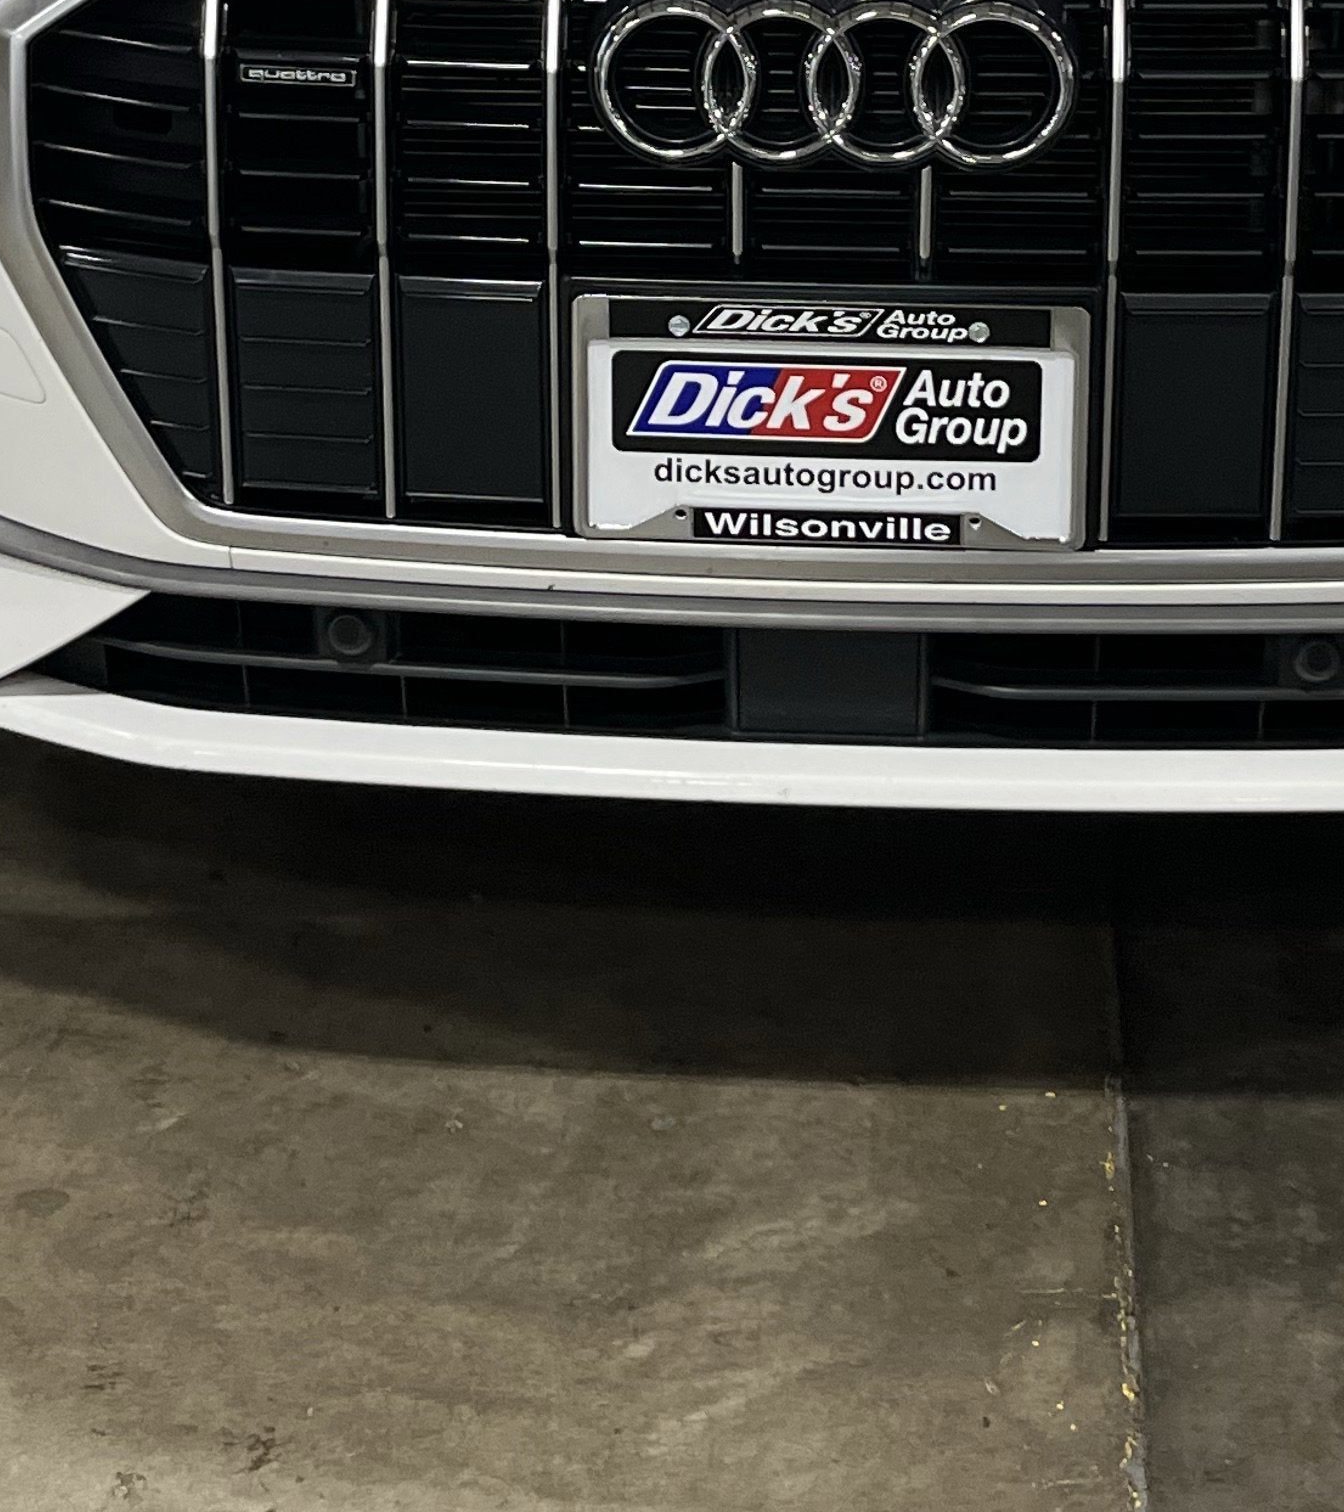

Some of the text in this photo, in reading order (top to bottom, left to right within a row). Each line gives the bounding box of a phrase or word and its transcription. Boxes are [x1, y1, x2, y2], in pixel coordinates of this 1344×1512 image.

[248, 68, 346, 83] quattro
[876, 323, 968, 342] Group
[883, 310, 956, 326] Auto
[903, 369, 1010, 408] Auto
[895, 407, 1028, 454] Group
[654, 457, 997, 495] dicksautogroup.com
[705, 511, 952, 541] Wilsonville
